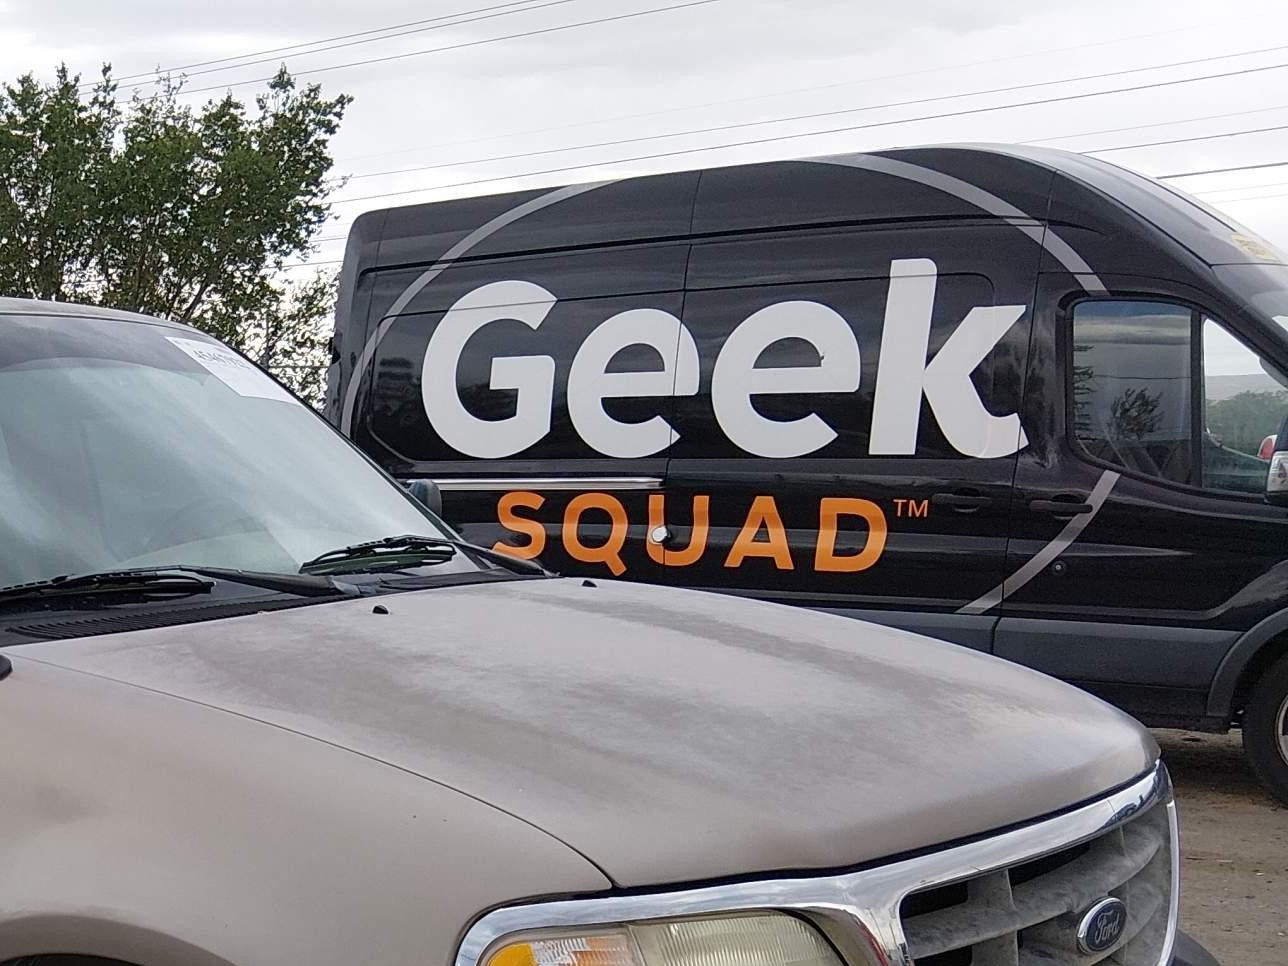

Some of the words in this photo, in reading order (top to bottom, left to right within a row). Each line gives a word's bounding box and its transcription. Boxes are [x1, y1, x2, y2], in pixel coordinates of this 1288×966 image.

[421, 258, 1029, 459] Geek
[492, 491, 887, 576] SQUAD
[893, 499, 929, 518] TM
[1095, 909, 1120, 945] Ford
